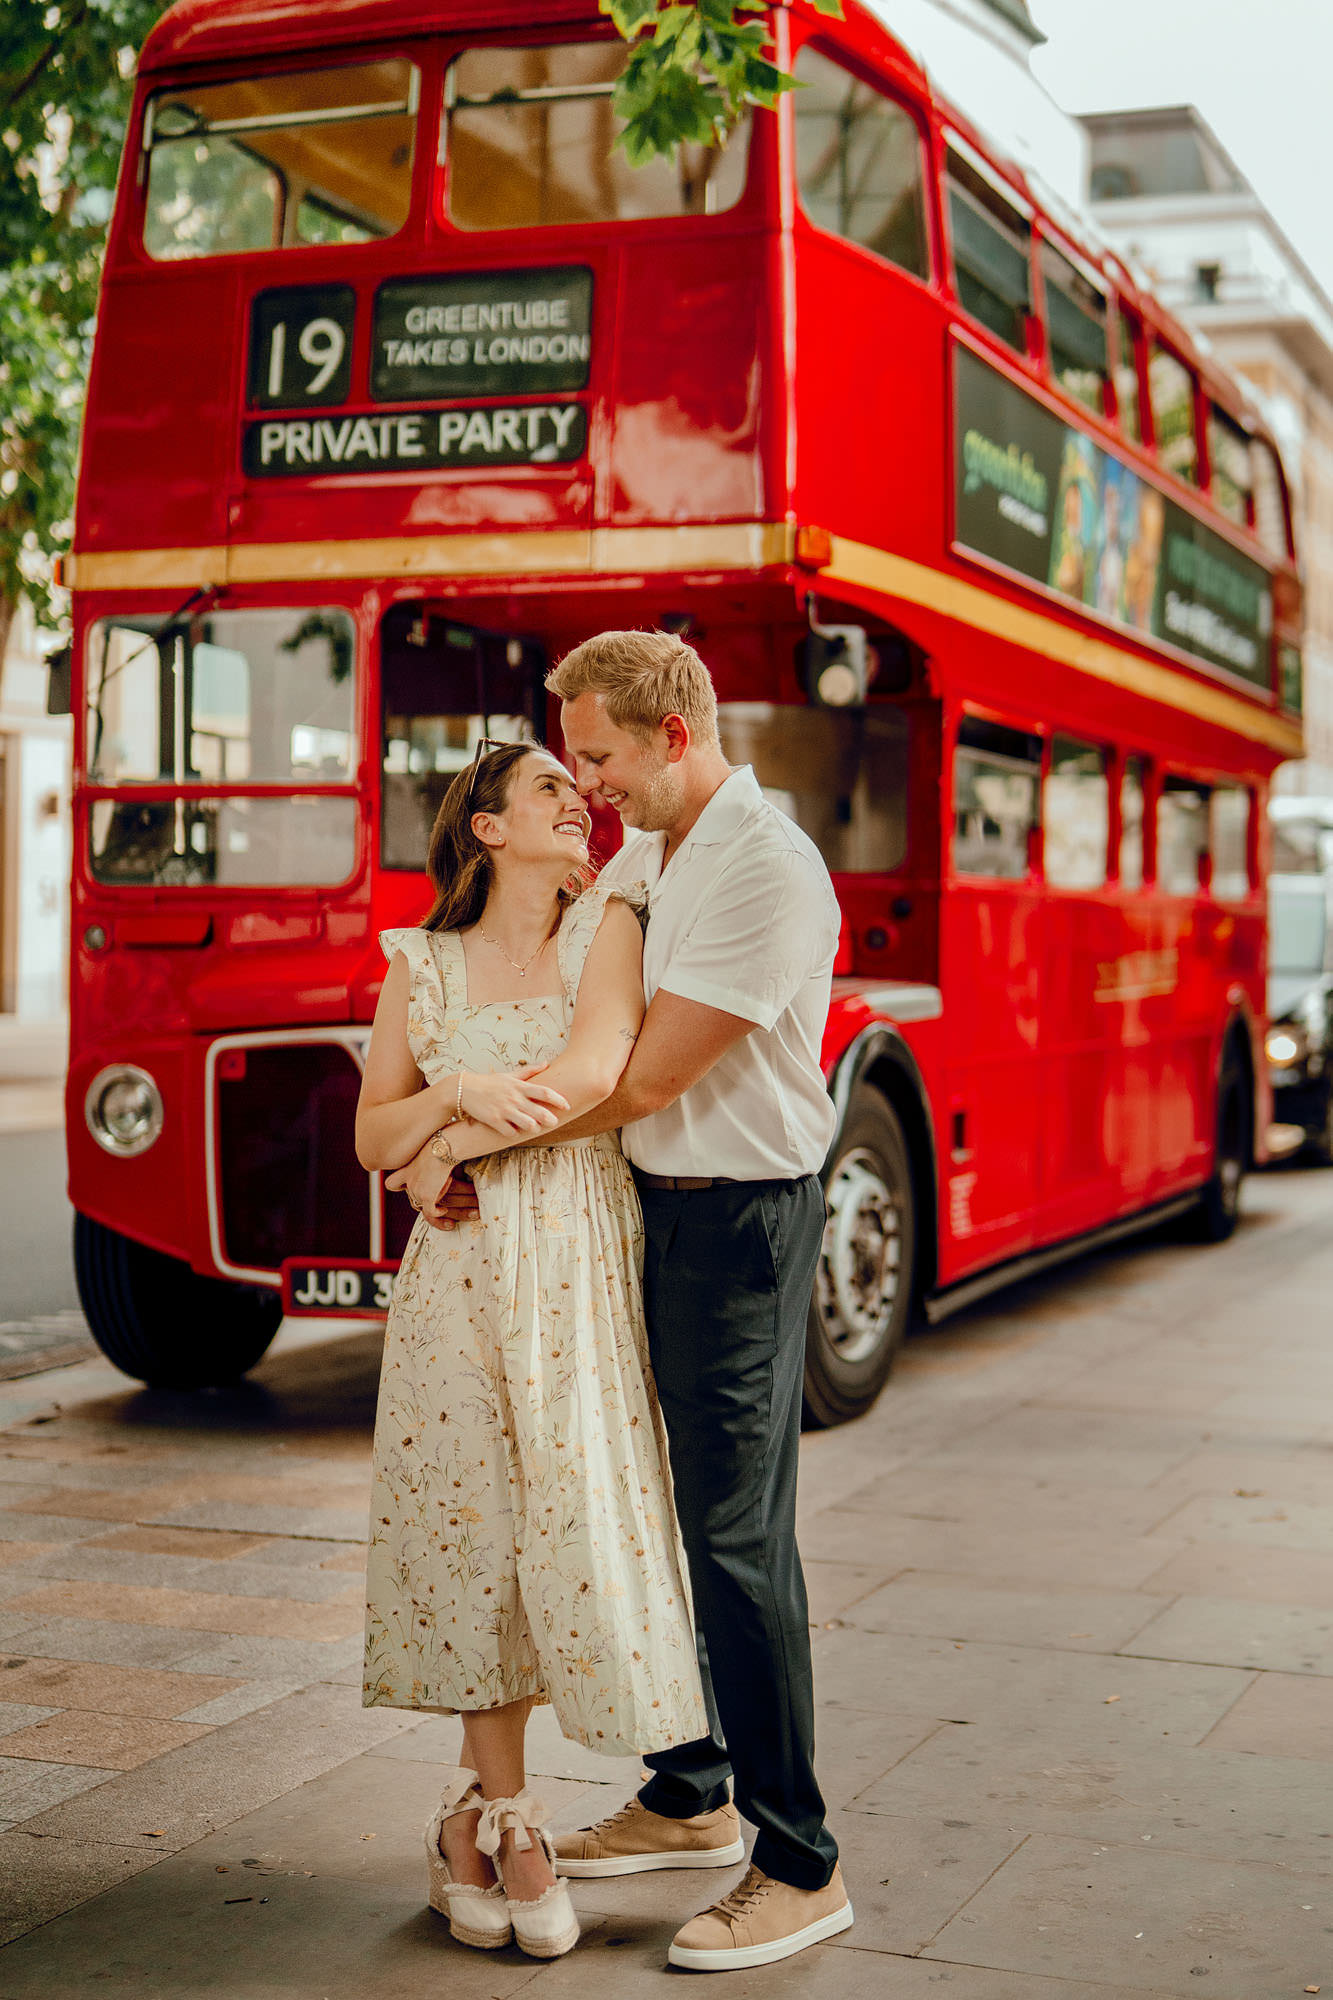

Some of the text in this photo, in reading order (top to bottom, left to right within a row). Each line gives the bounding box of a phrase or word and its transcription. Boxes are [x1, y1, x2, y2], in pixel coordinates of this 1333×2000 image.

[406, 300, 568, 334] GREENTUBE
[269, 318, 345, 396] 19
[383, 335, 589, 366] TAKES LONDON
[262, 407, 577, 464] PRIVATE PARTY
[296, 1270, 398, 1308] JJD 3
